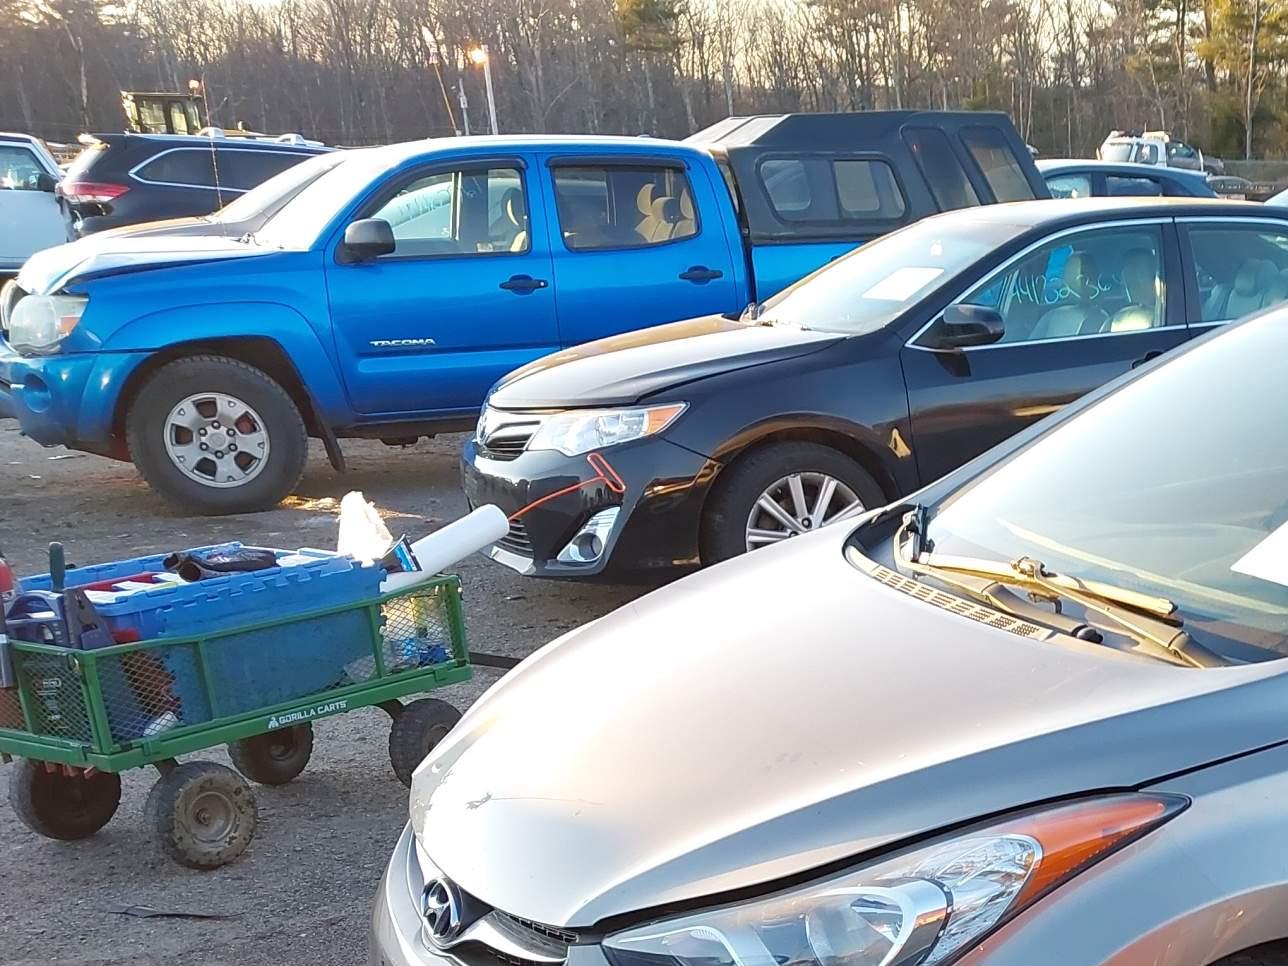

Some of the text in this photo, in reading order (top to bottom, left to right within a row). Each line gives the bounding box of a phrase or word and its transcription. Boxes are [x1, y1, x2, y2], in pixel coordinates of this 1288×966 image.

[369, 338, 436, 347] TACOMA
[278, 701, 347, 725] GORILLA CARTS
